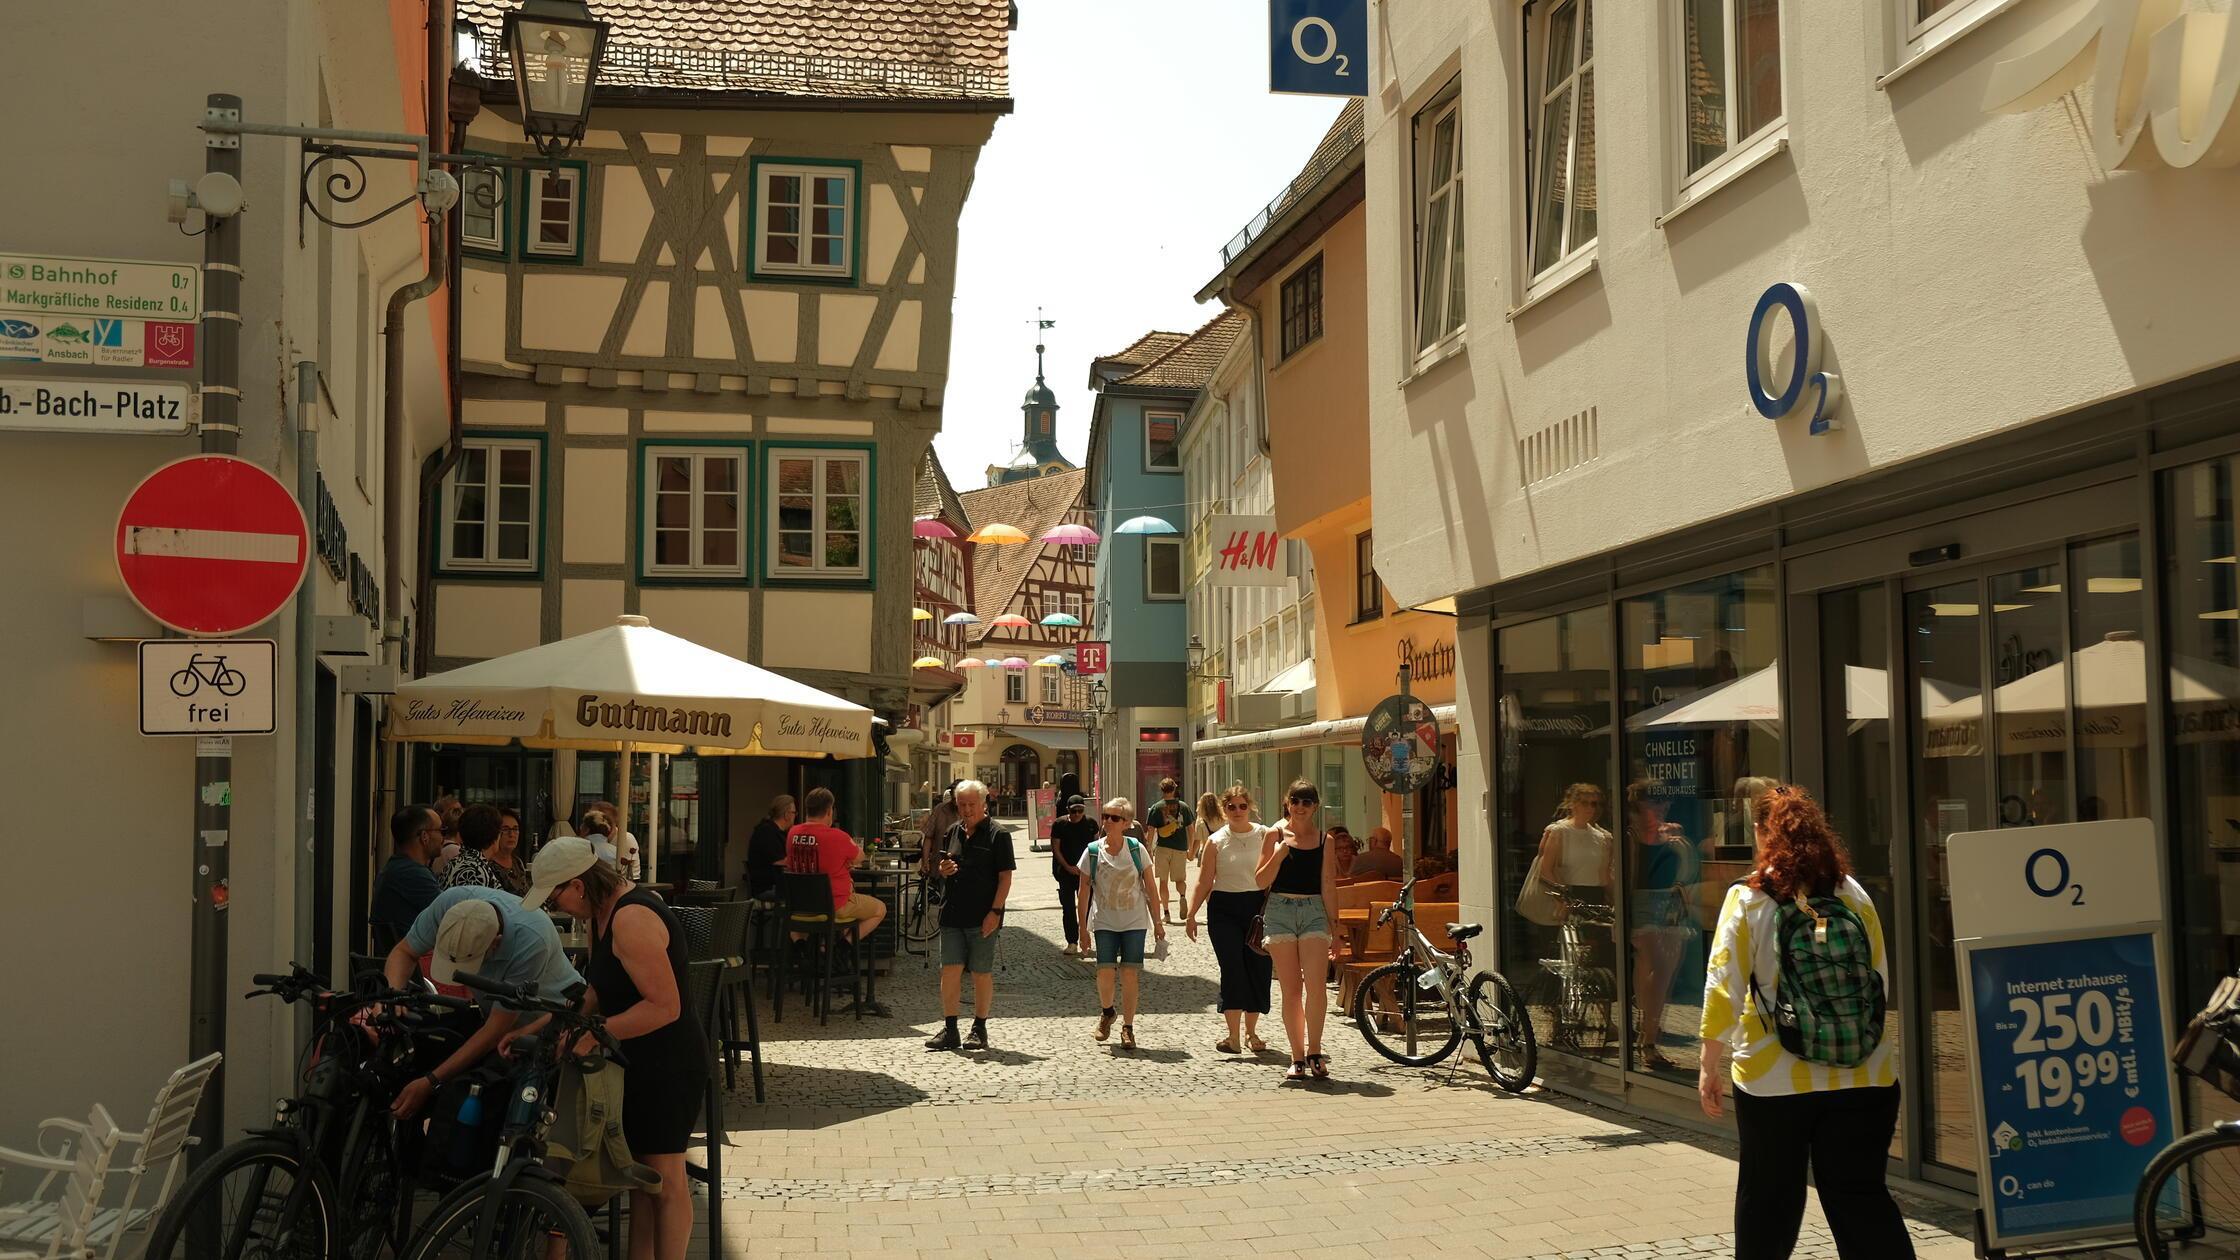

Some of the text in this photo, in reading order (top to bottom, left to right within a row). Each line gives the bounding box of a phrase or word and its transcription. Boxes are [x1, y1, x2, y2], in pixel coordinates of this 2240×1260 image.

[32, 265, 118, 285] Bahnhof
[7, 290, 100, 309] Markgräfliche
[107, 295, 164, 312] Residenz
[48, 349, 89, 359] Ansbach
[149, 358, 189, 366] Burgenstraße
[1219, 531, 1279, 571] H&M
[188, 703, 231, 722] frei
[405, 699, 525, 727] Gutes Hefeweizen
[576, 694, 732, 737] Gutmann
[1046, 711, 1068, 720] KORFU
[777, 712, 860, 744] Gutes Hefeweizen
[1645, 739, 1695, 757] CHNELLES
[1653, 785, 1667, 795] DEIN
[1668, 785, 1696, 795] ZUHAUSE
[792, 835, 819, 846] R.E.D.
[2007, 973, 2128, 995] Internet zuhause:
[1995, 1022, 2007, 1031] Bis
[2008, 990, 2115, 1054] 250
[2115, 987, 2134, 1043] MBit/s
[2001, 1049, 2140, 1116] ab 19,99 € mtl.
[2027, 1182, 2042, 1190] can
[2043, 1179, 2056, 1188] do
